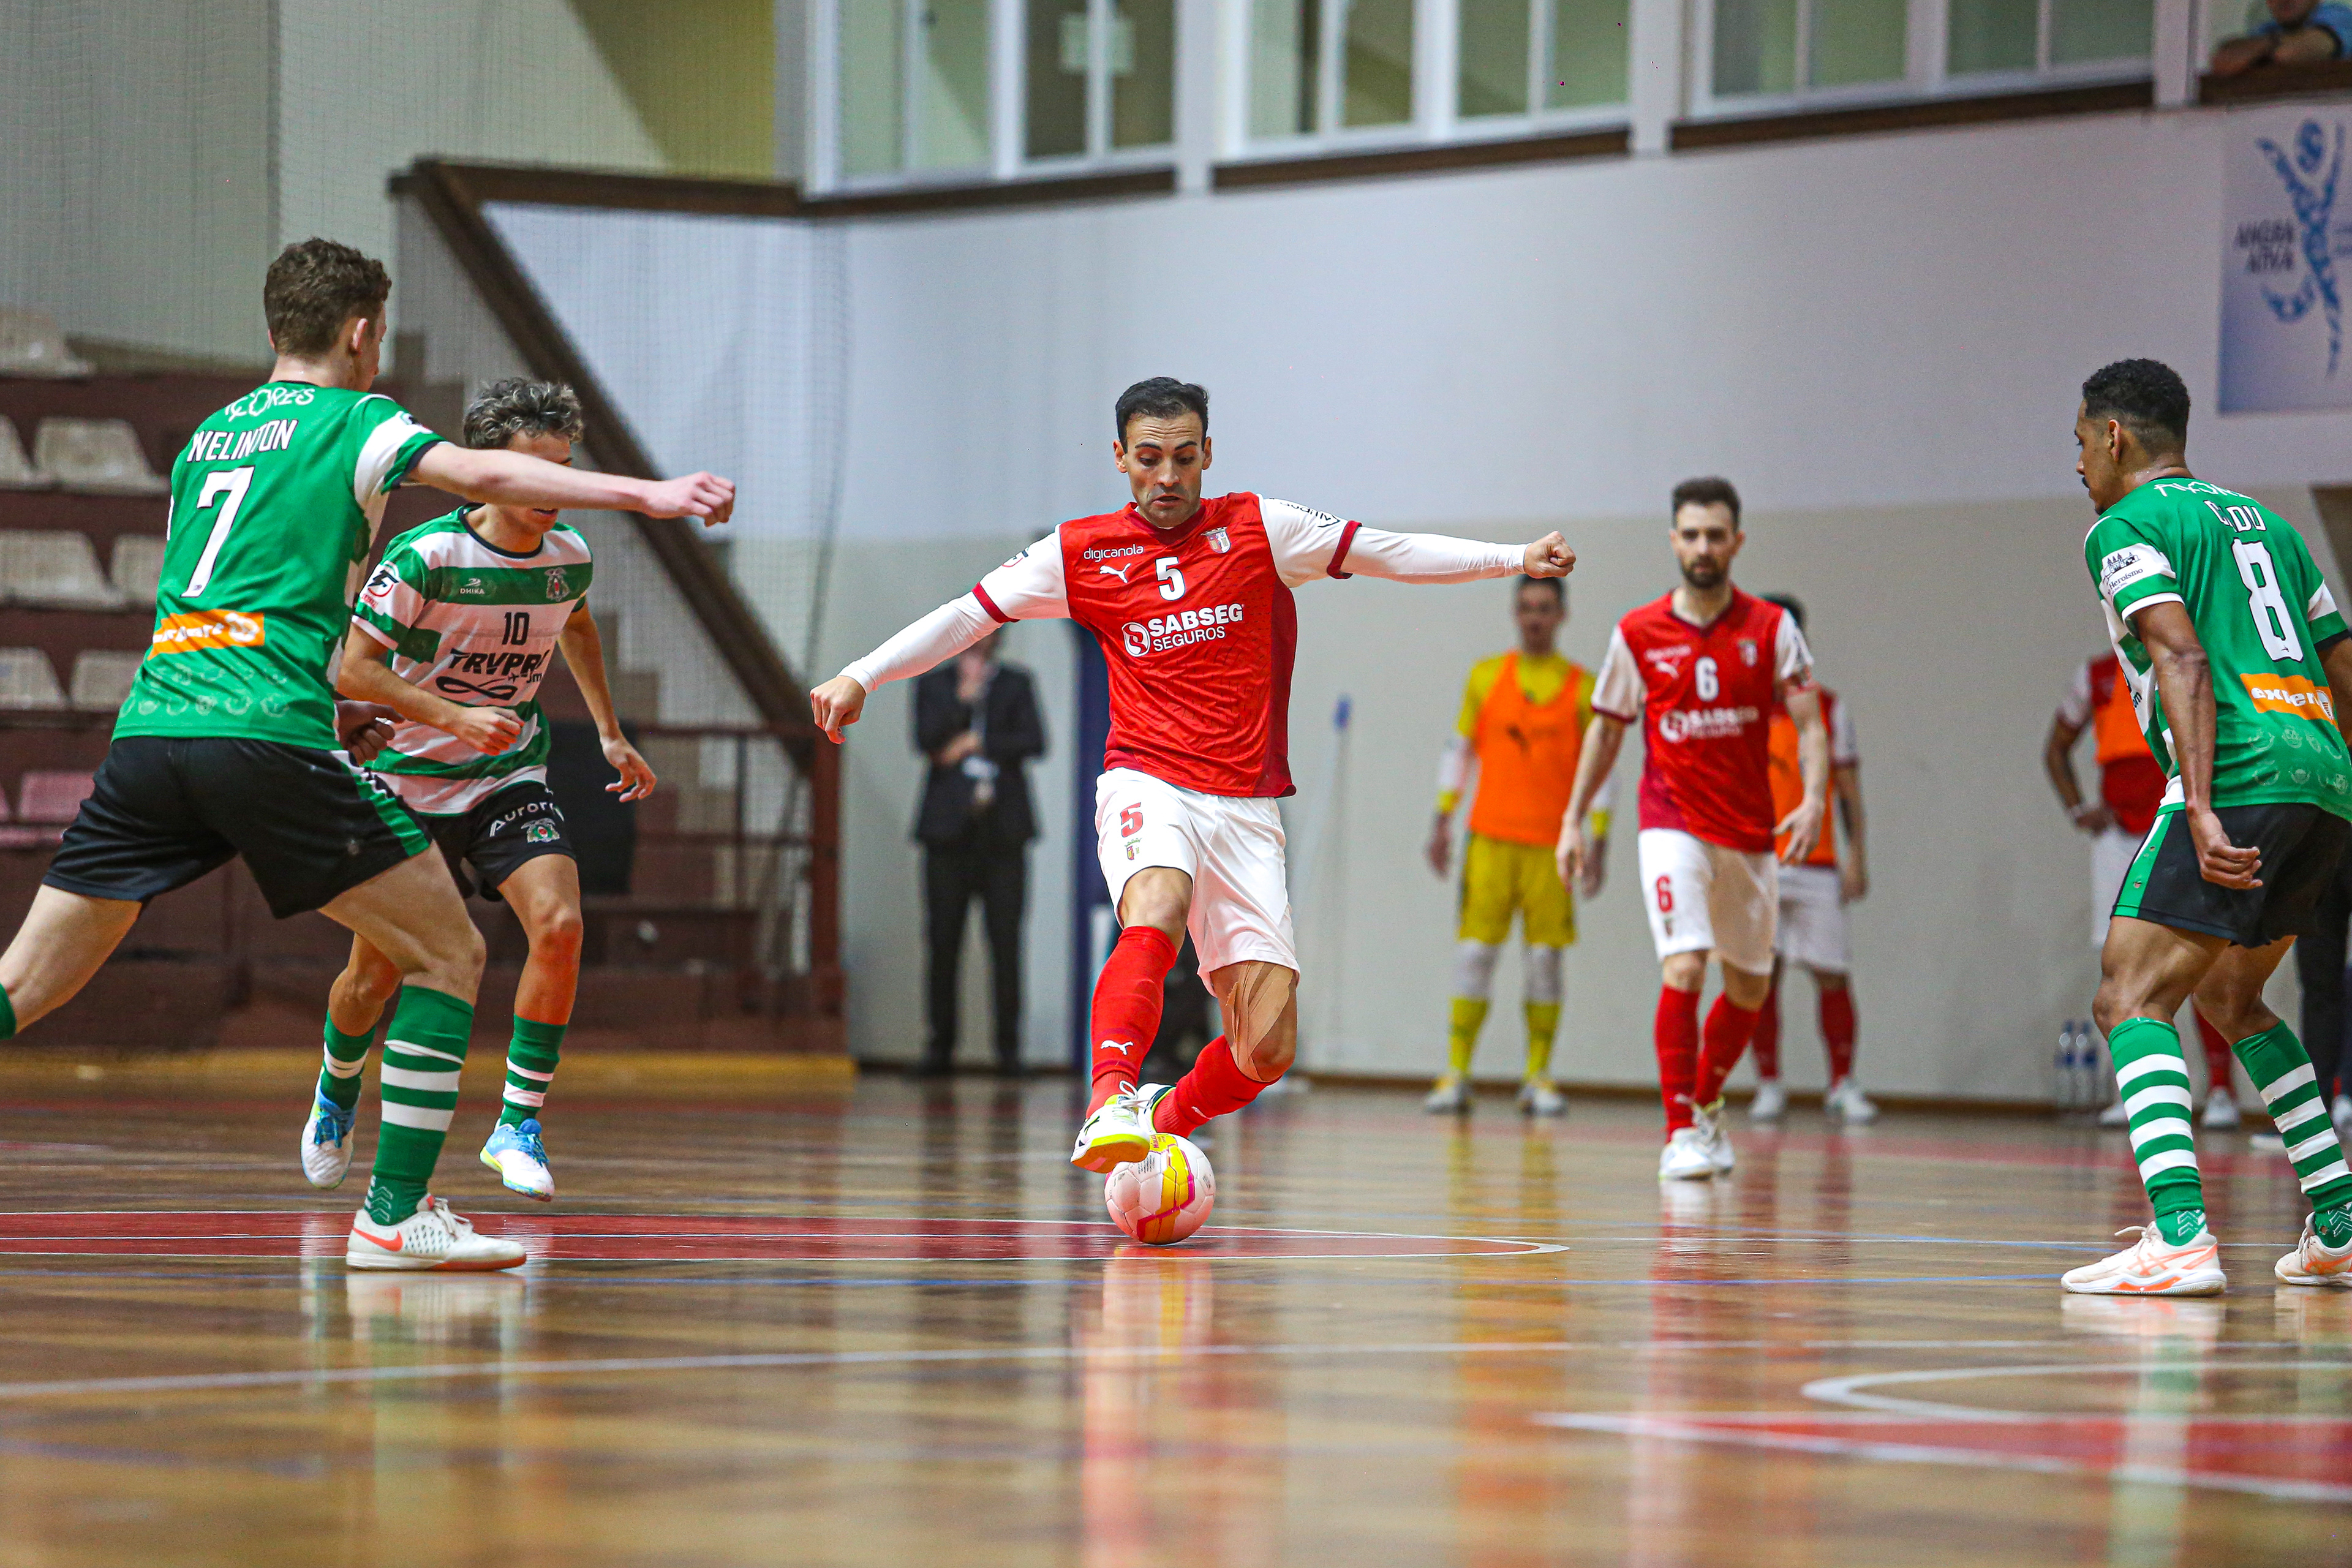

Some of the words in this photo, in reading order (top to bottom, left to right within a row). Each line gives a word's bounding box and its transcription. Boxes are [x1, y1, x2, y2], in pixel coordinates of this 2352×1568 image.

[181, 466, 255, 598] 7
[2204, 500, 2267, 532] CDU
[1084, 544, 1144, 562] digicanola
[1155, 556, 1185, 601] 5
[2231, 537, 2303, 663] 8
[502, 612, 530, 646] 10
[1148, 603, 1243, 637] SABSEG
[1153, 626, 1226, 652] SEGUROS
[1695, 656, 1720, 702] 6
[1120, 802, 1143, 838] 5
[1656, 875, 1673, 913] 6
